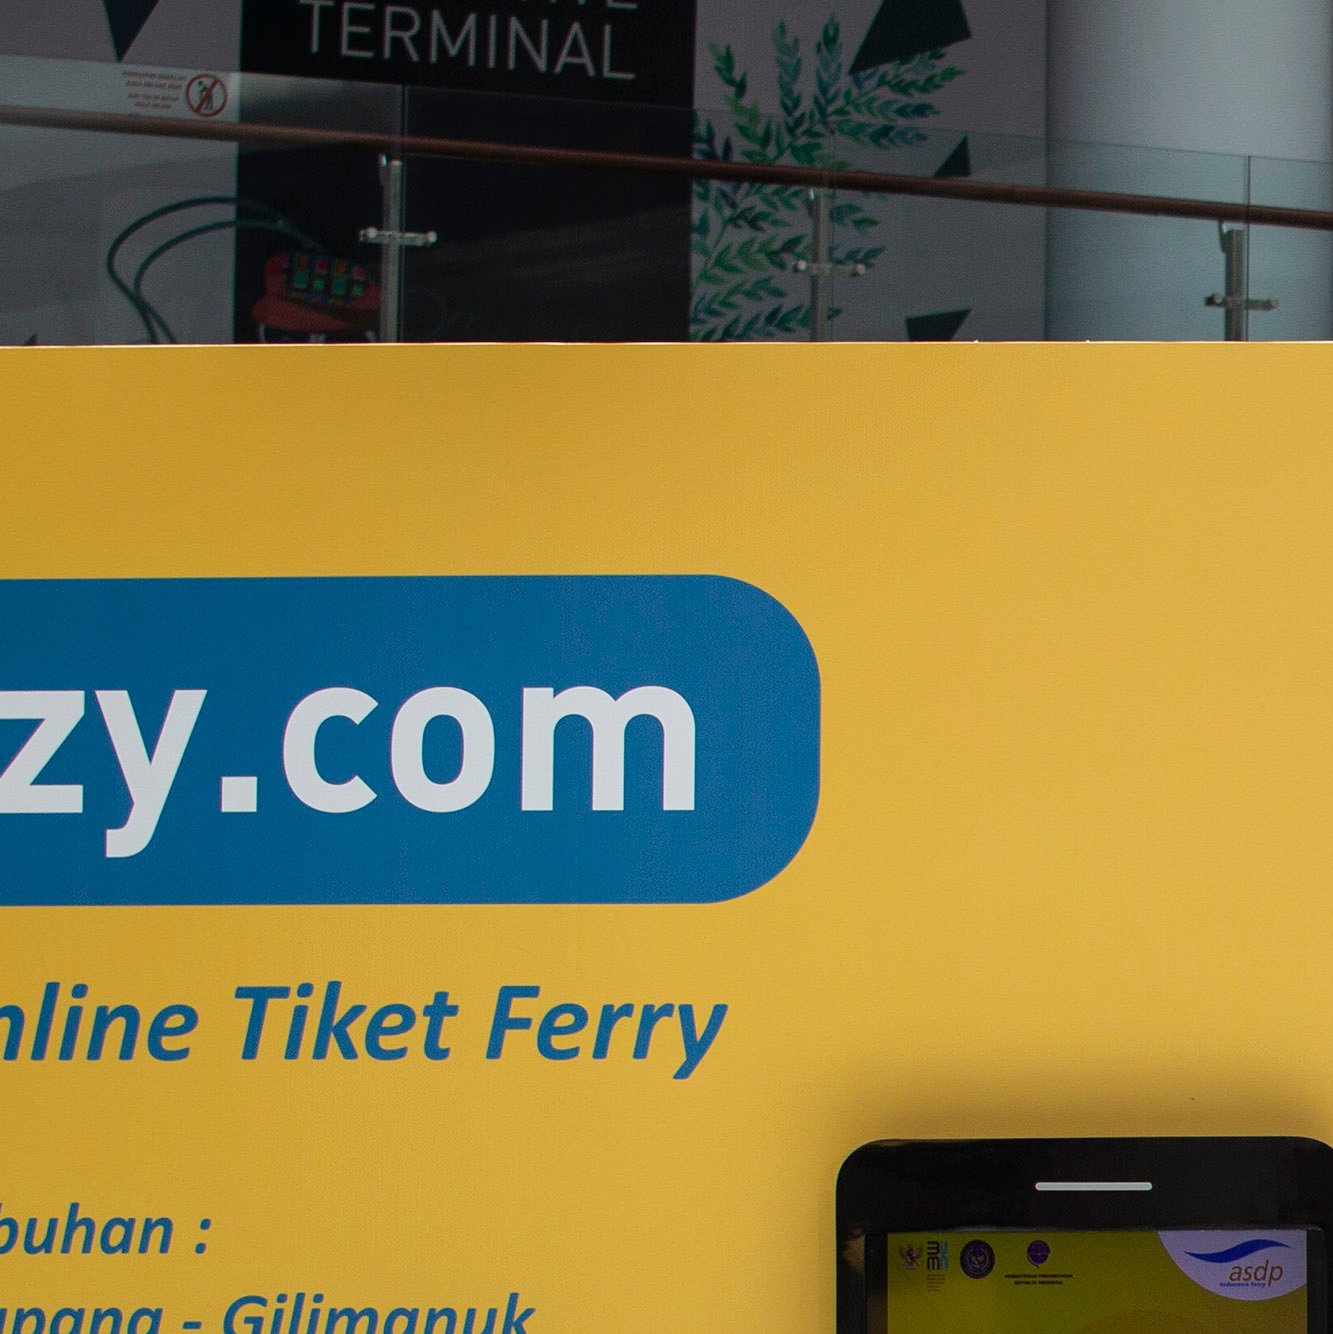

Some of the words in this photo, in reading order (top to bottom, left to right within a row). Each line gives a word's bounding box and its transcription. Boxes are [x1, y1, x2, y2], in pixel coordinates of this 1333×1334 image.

[304, 0, 637, 80] TERMINAL
[233, 980, 460, 1061] Tiket
[484, 984, 729, 1080] Ferry
[1229, 1259, 1284, 1287] asdp
